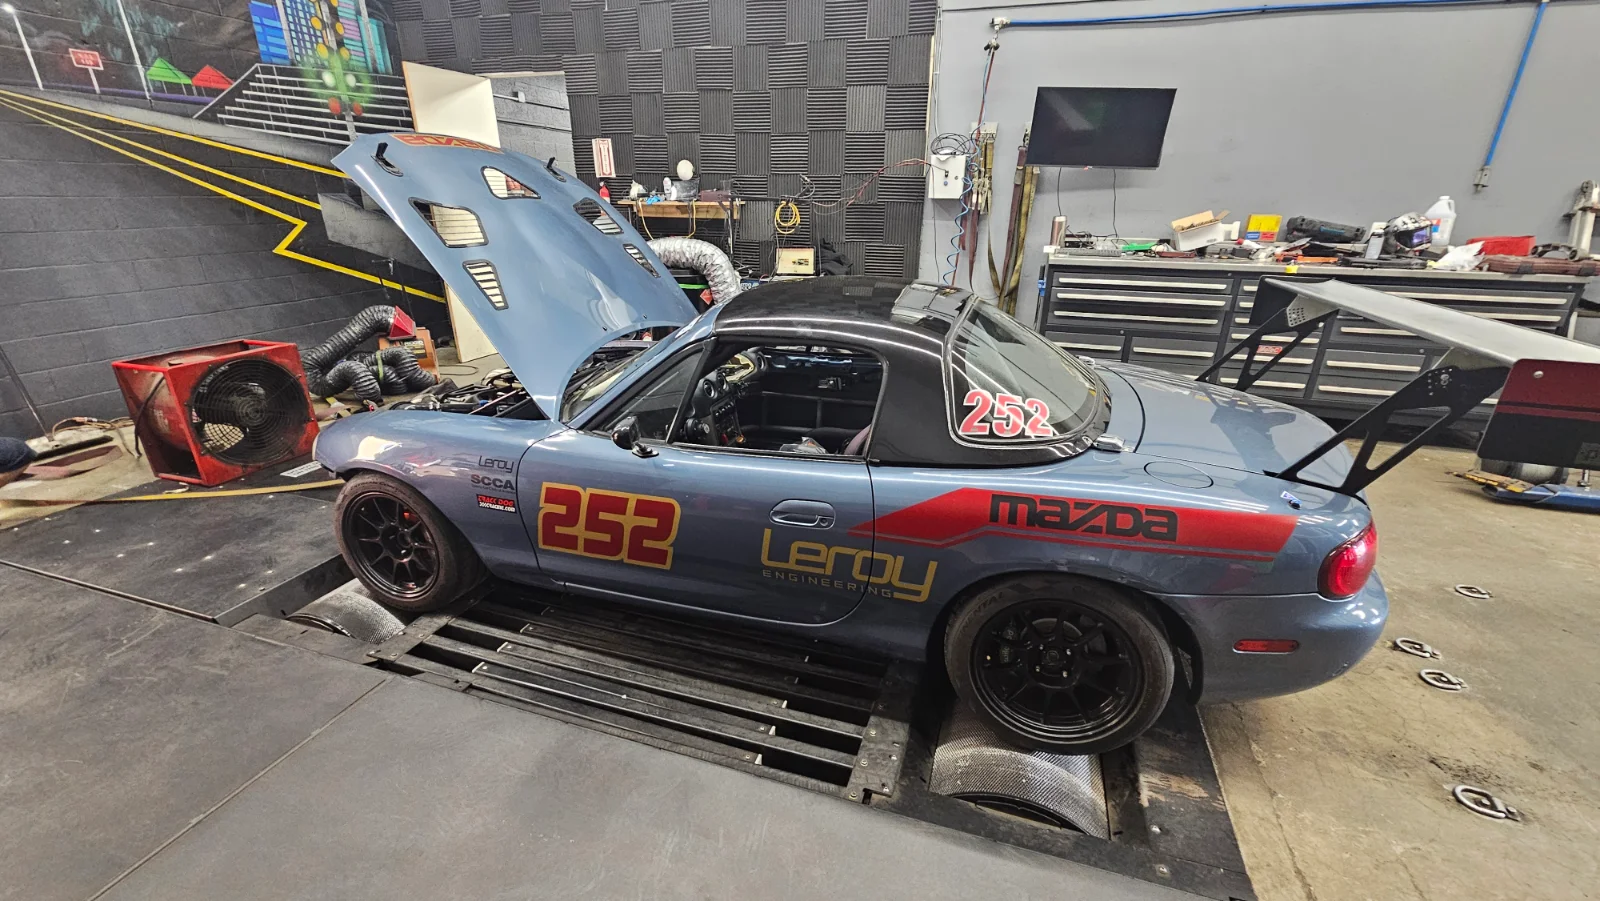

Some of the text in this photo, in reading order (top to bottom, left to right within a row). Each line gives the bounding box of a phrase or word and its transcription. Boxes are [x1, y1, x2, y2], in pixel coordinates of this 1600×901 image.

[959, 389, 1054, 437] 252
[471, 474, 515, 490] SCCA
[479, 456, 514, 473] Leroy
[538, 482, 682, 570] 252
[761, 528, 938, 603] Leroy
[763, 569, 895, 598] ENGINEERING
